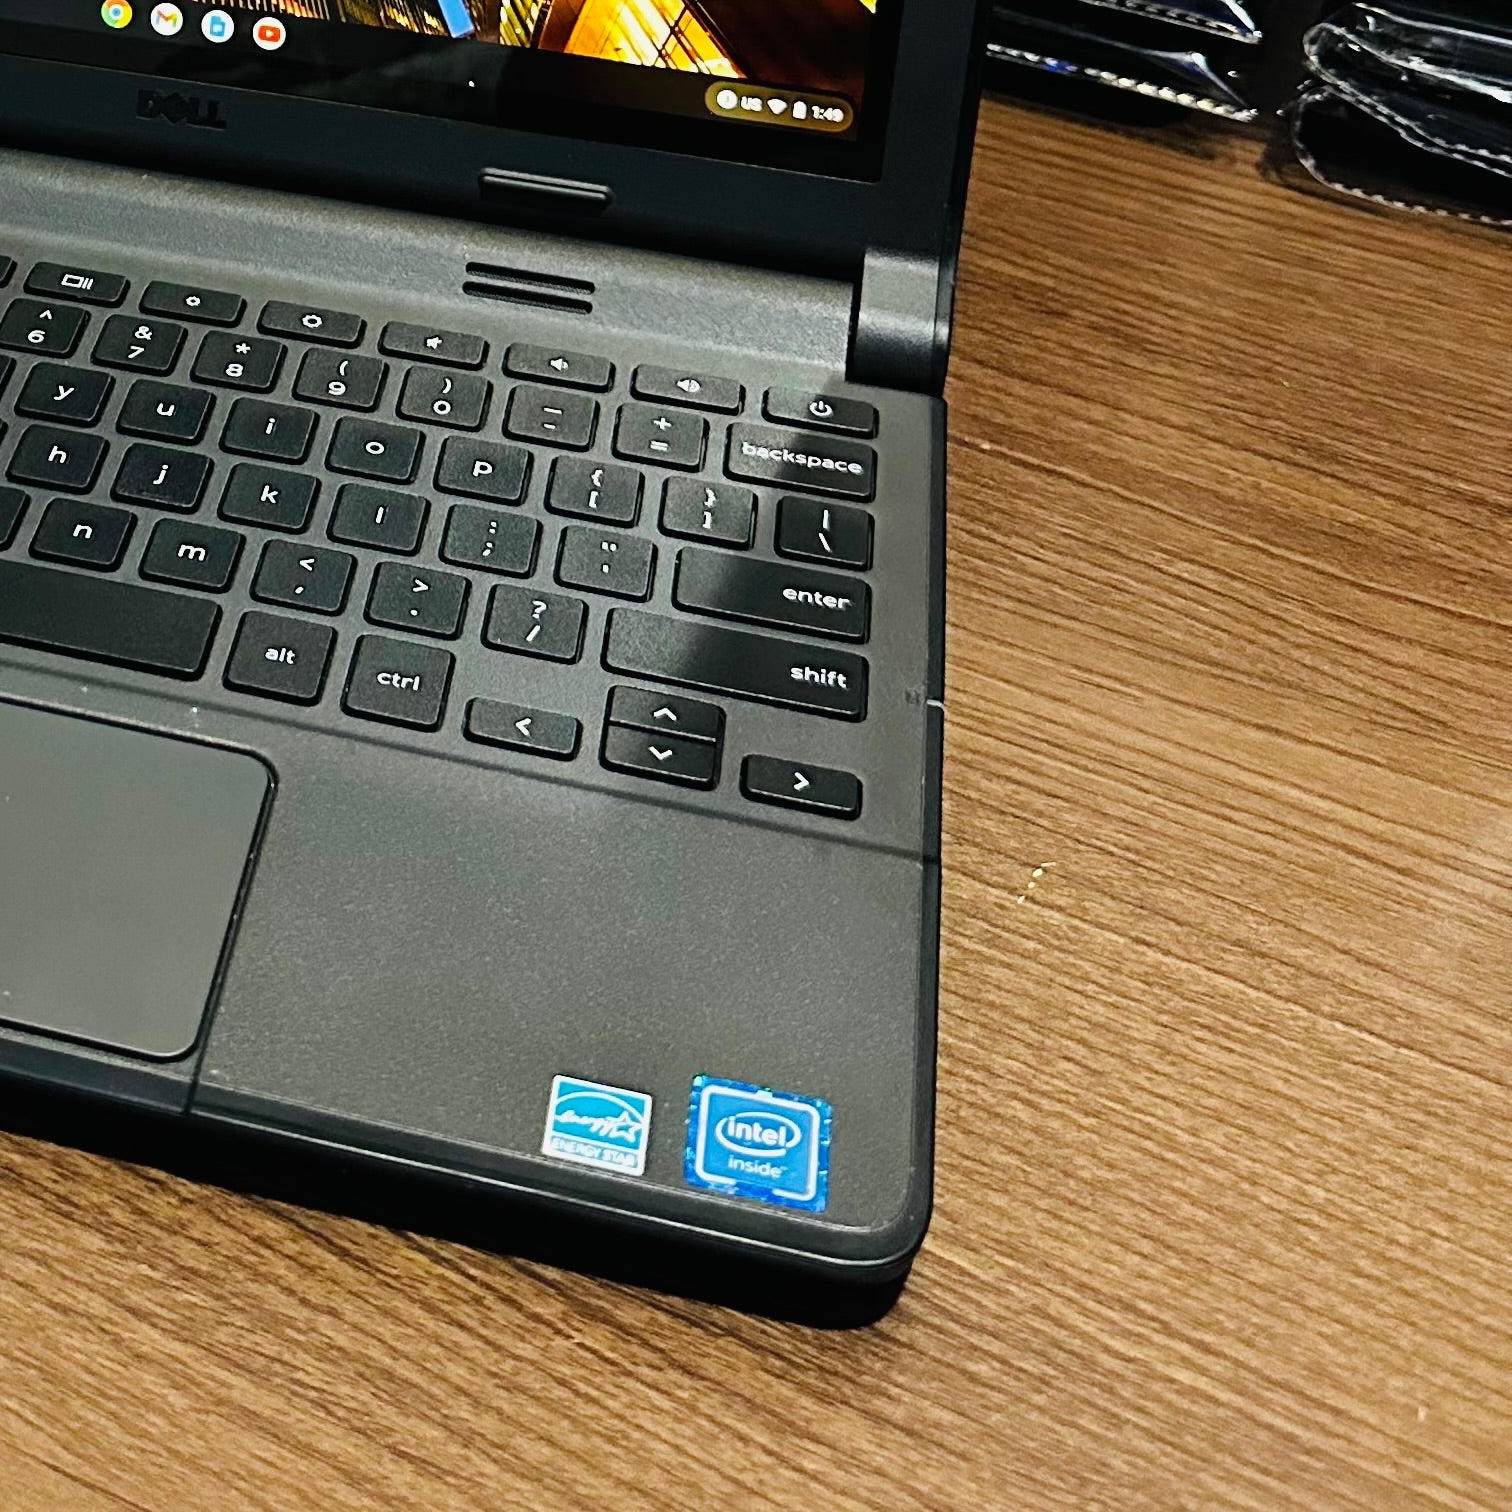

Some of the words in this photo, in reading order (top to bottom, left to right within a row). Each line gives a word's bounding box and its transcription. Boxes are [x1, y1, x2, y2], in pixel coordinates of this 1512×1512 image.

[137, 90, 227, 129] DELL
[27, 329, 46, 344] 6
[127, 345, 145, 359] 7
[225, 363, 244, 378] 8
[53, 385, 75, 401] y
[328, 381, 346, 396] 9
[156, 402, 175, 417] u
[265, 417, 276, 435] i
[47, 445, 67, 464] h
[365, 441, 385, 455] o
[740, 440, 864, 476] backspace
[152, 464, 169, 485] j
[472, 460, 493, 477] p
[260, 485, 279, 504] k
[72, 524, 93, 539] n
[177, 544, 206, 561] m
[782, 588, 851, 609] enter
[264, 647, 296, 665] alt
[376, 672, 420, 691] ctrl
[790, 666, 847, 689] shift
[727, 1117, 787, 1146] intel
